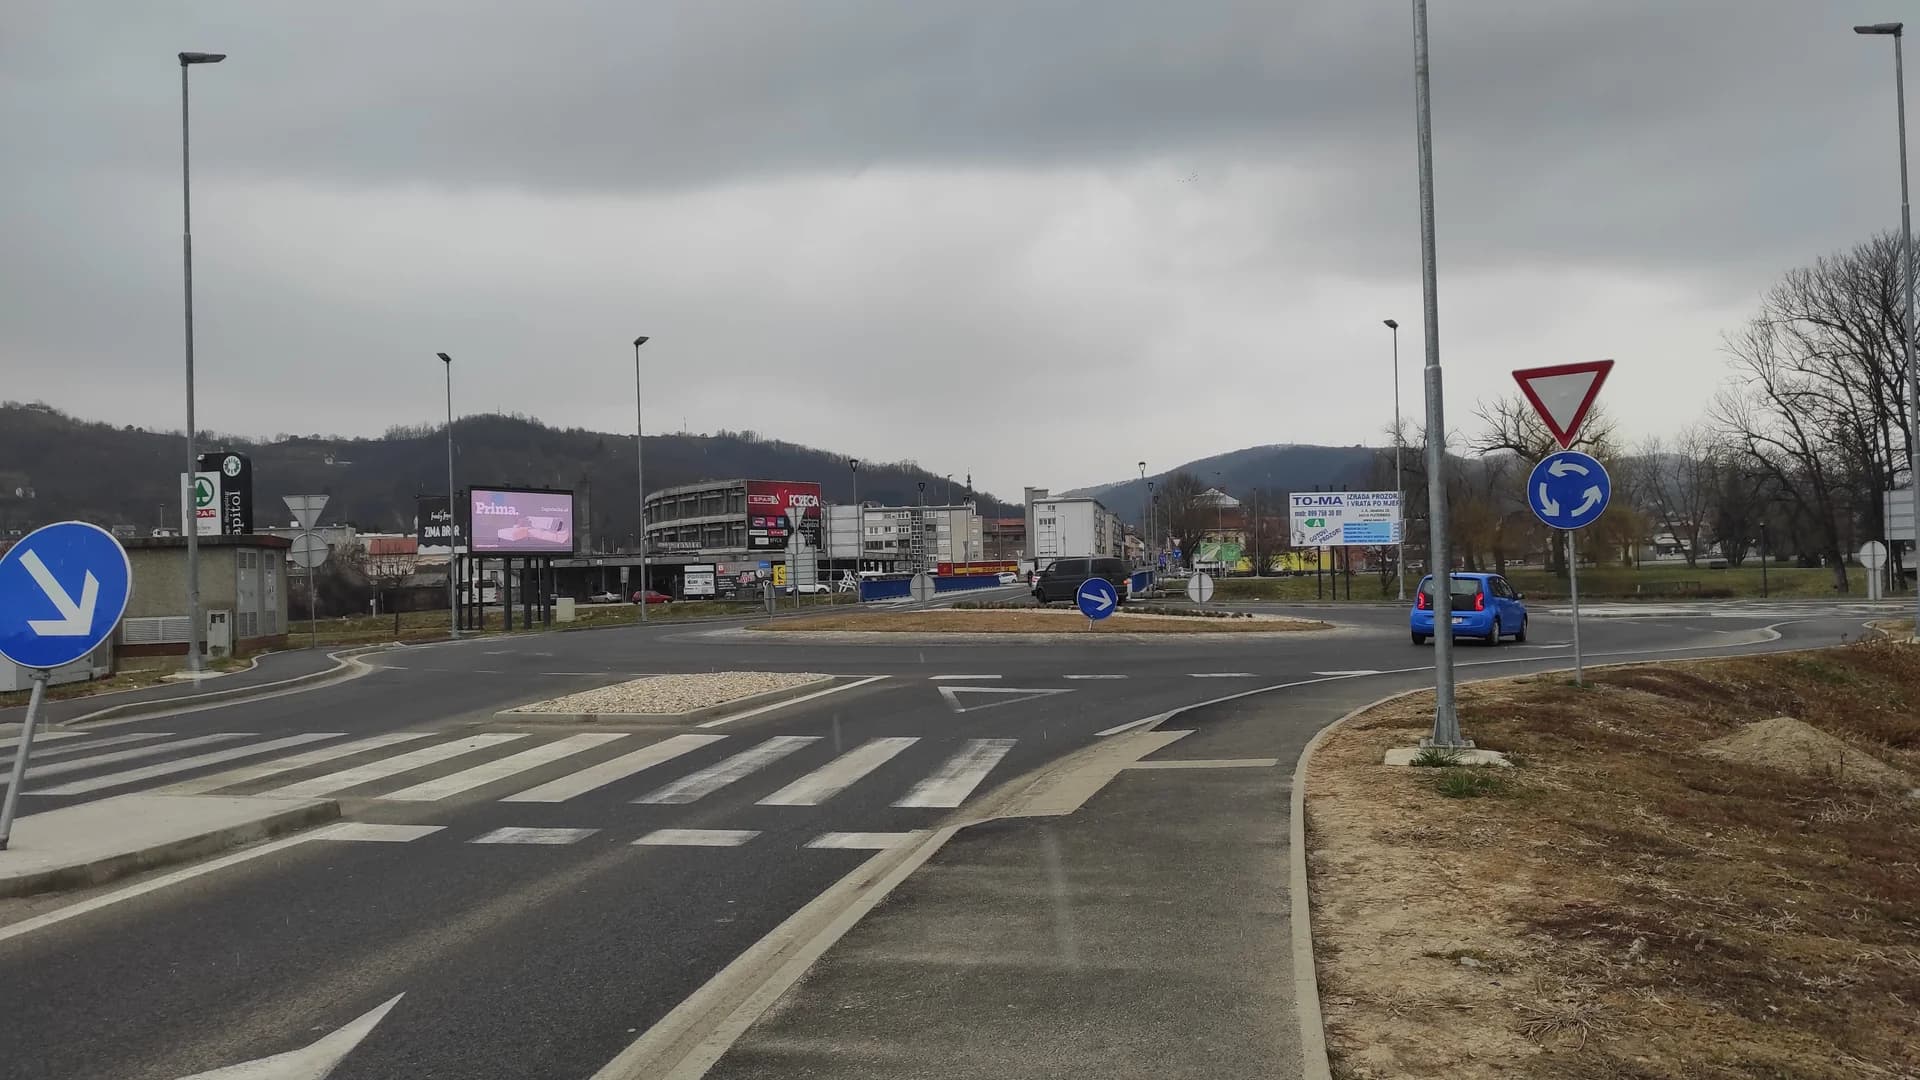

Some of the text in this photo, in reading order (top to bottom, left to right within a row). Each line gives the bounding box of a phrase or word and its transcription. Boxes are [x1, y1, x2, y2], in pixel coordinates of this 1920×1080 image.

[1292, 496, 1343, 506] TO-MA
[196, 509, 216, 517] PAR
[230, 490, 244, 535] apitol
[475, 502, 520, 515] Prima.
[424, 526, 441, 538] ZIMA
